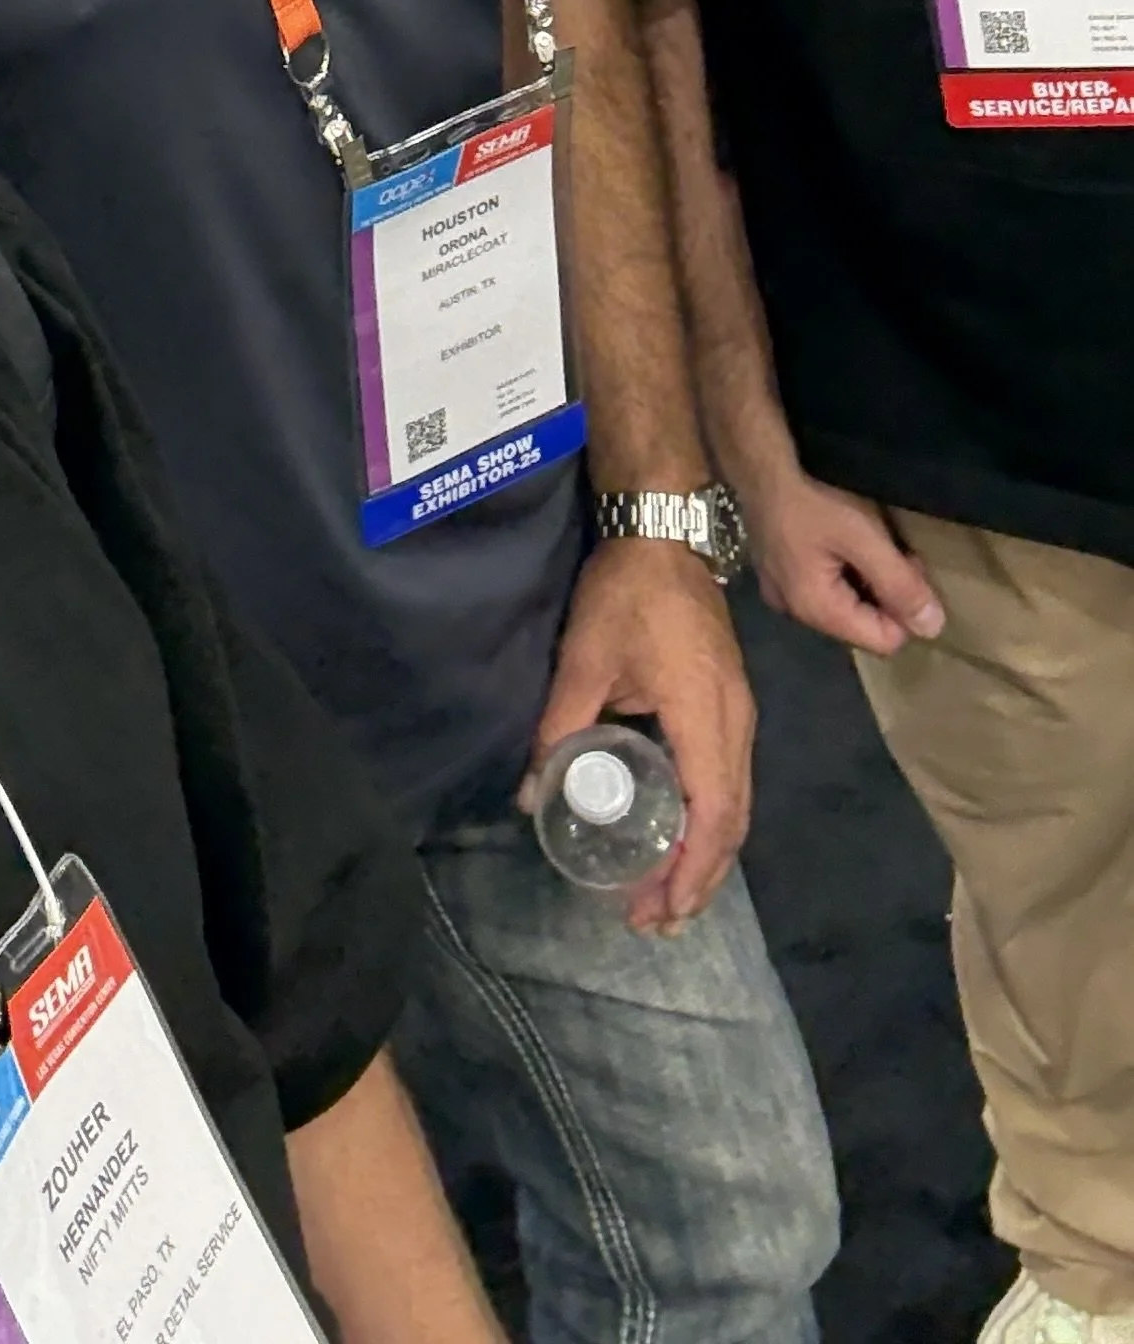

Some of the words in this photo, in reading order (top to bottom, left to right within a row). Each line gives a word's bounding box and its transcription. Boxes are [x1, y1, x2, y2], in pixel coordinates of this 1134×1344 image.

[1032, 81, 1118, 97] BUYER-
[475, 124, 533, 159] SEMA
[421, 195, 501, 242] HOUSTON
[438, 226, 489, 257] ORONA
[421, 232, 508, 282] MIRACLECOAT
[481, 277, 497, 290] TX
[440, 324, 503, 362] EXHIBITOR
[412, 447, 542, 520] EXHIBITOR-25
[418, 465, 474, 501] SEMA
[476, 434, 534, 472] SHOW
[28, 944, 96, 1039] SEMA
[42, 1101, 113, 1213] ZOUHER
[58, 1128, 139, 1263] HERNANDEZ
[77, 1220, 115, 1287] NIFTY
[109, 1164, 150, 1230] MITTS
[116, 1315, 134, 1343] EL
[156, 1233, 178, 1263] TX
[164, 1275, 202, 1340] DETAIL
[195, 1199, 244, 1277] SERVICE
